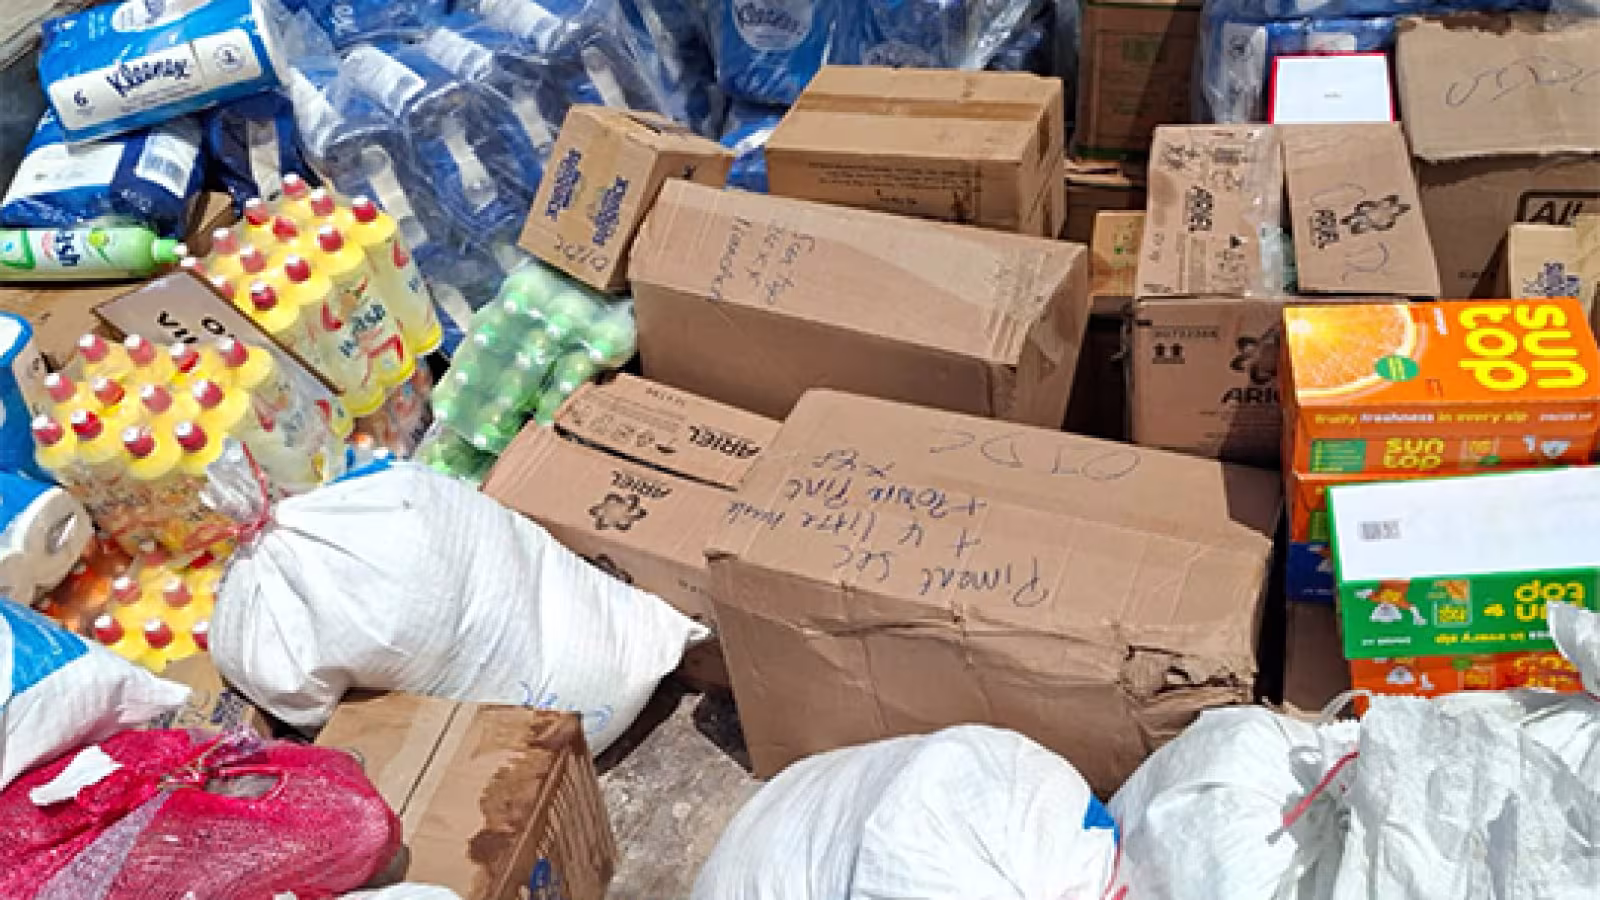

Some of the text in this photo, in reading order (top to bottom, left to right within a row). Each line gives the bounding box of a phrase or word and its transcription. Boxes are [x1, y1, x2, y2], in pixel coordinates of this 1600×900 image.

[106, 57, 191, 97] Kleenex
[73, 89, 89, 107] 6
[1457, 306, 1529, 391] top
[1514, 304, 1588, 389] sun
[1220, 386, 1281, 404] ARI
[688, 425, 762, 459] ARIEL
[1385, 438, 1446, 454] sun
[1383, 454, 1442, 470] top
[611, 470, 673, 499] ARIEL
[1513, 579, 1586, 608] top
